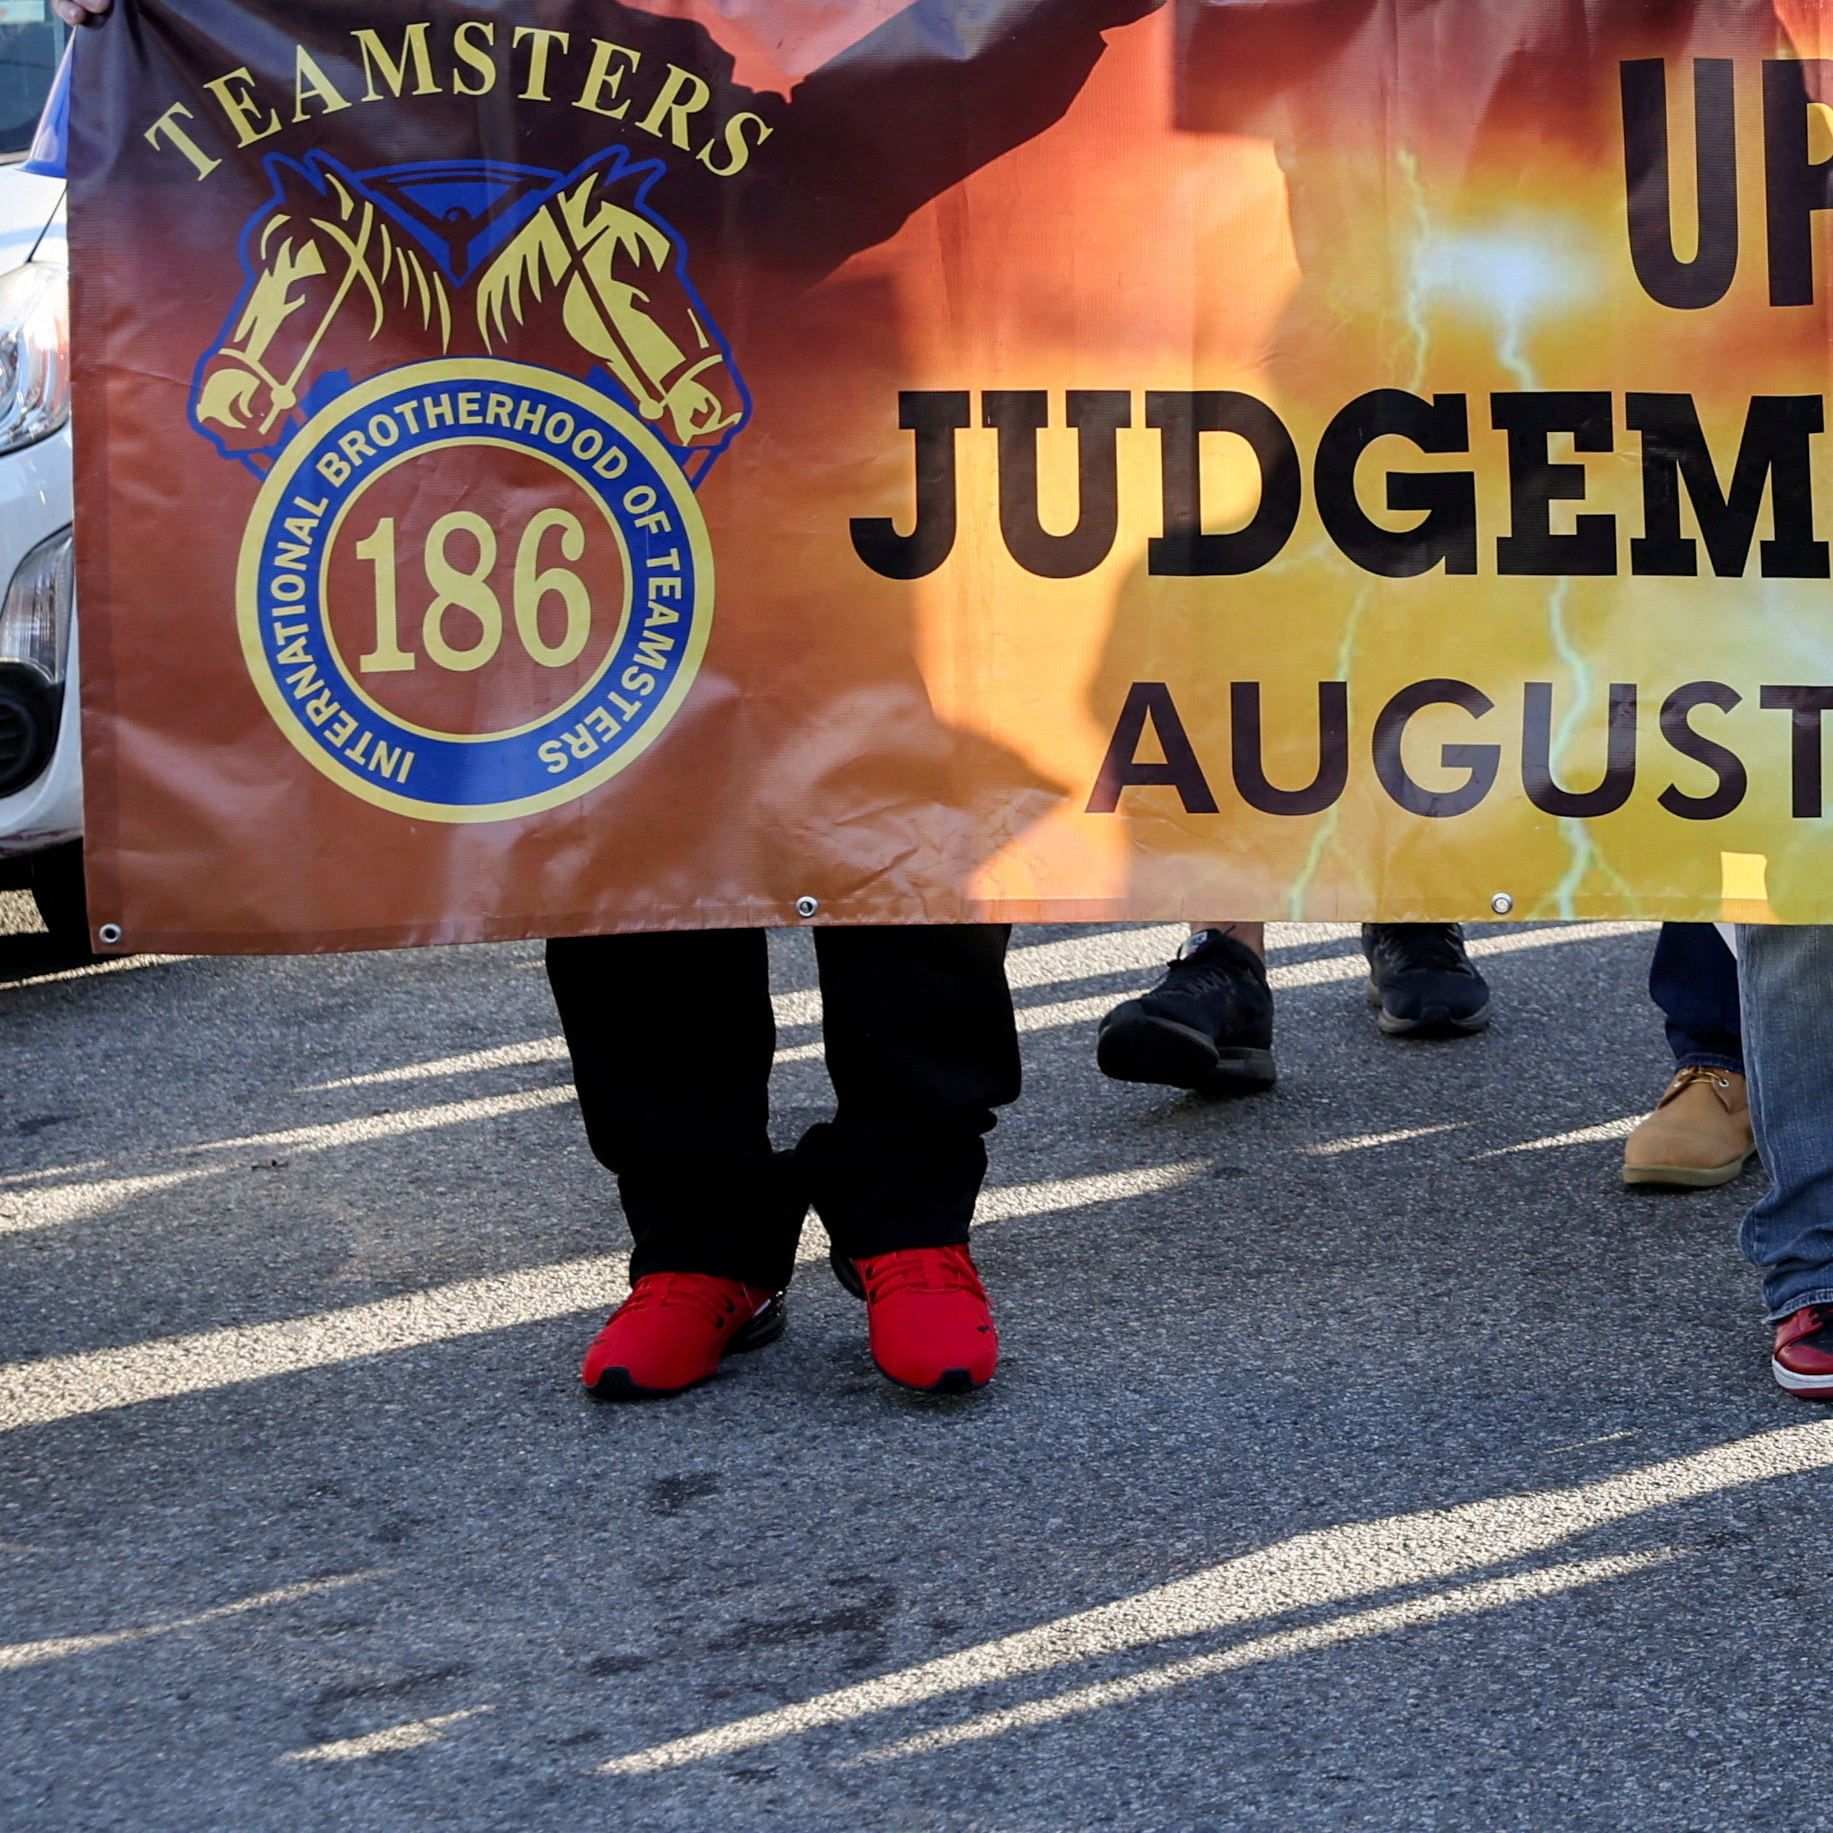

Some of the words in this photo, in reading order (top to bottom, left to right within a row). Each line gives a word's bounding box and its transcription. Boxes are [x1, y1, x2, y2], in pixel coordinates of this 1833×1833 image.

[144, 21, 774, 182] TEAMSTERS
[316, 392, 629, 488] BROTHERHOOD
[623, 485, 662, 528] OF
[271, 492, 416, 785] INTERNATIONAL
[355, 507, 592, 675] 186
[538, 547, 683, 774] TEAMSTERS
